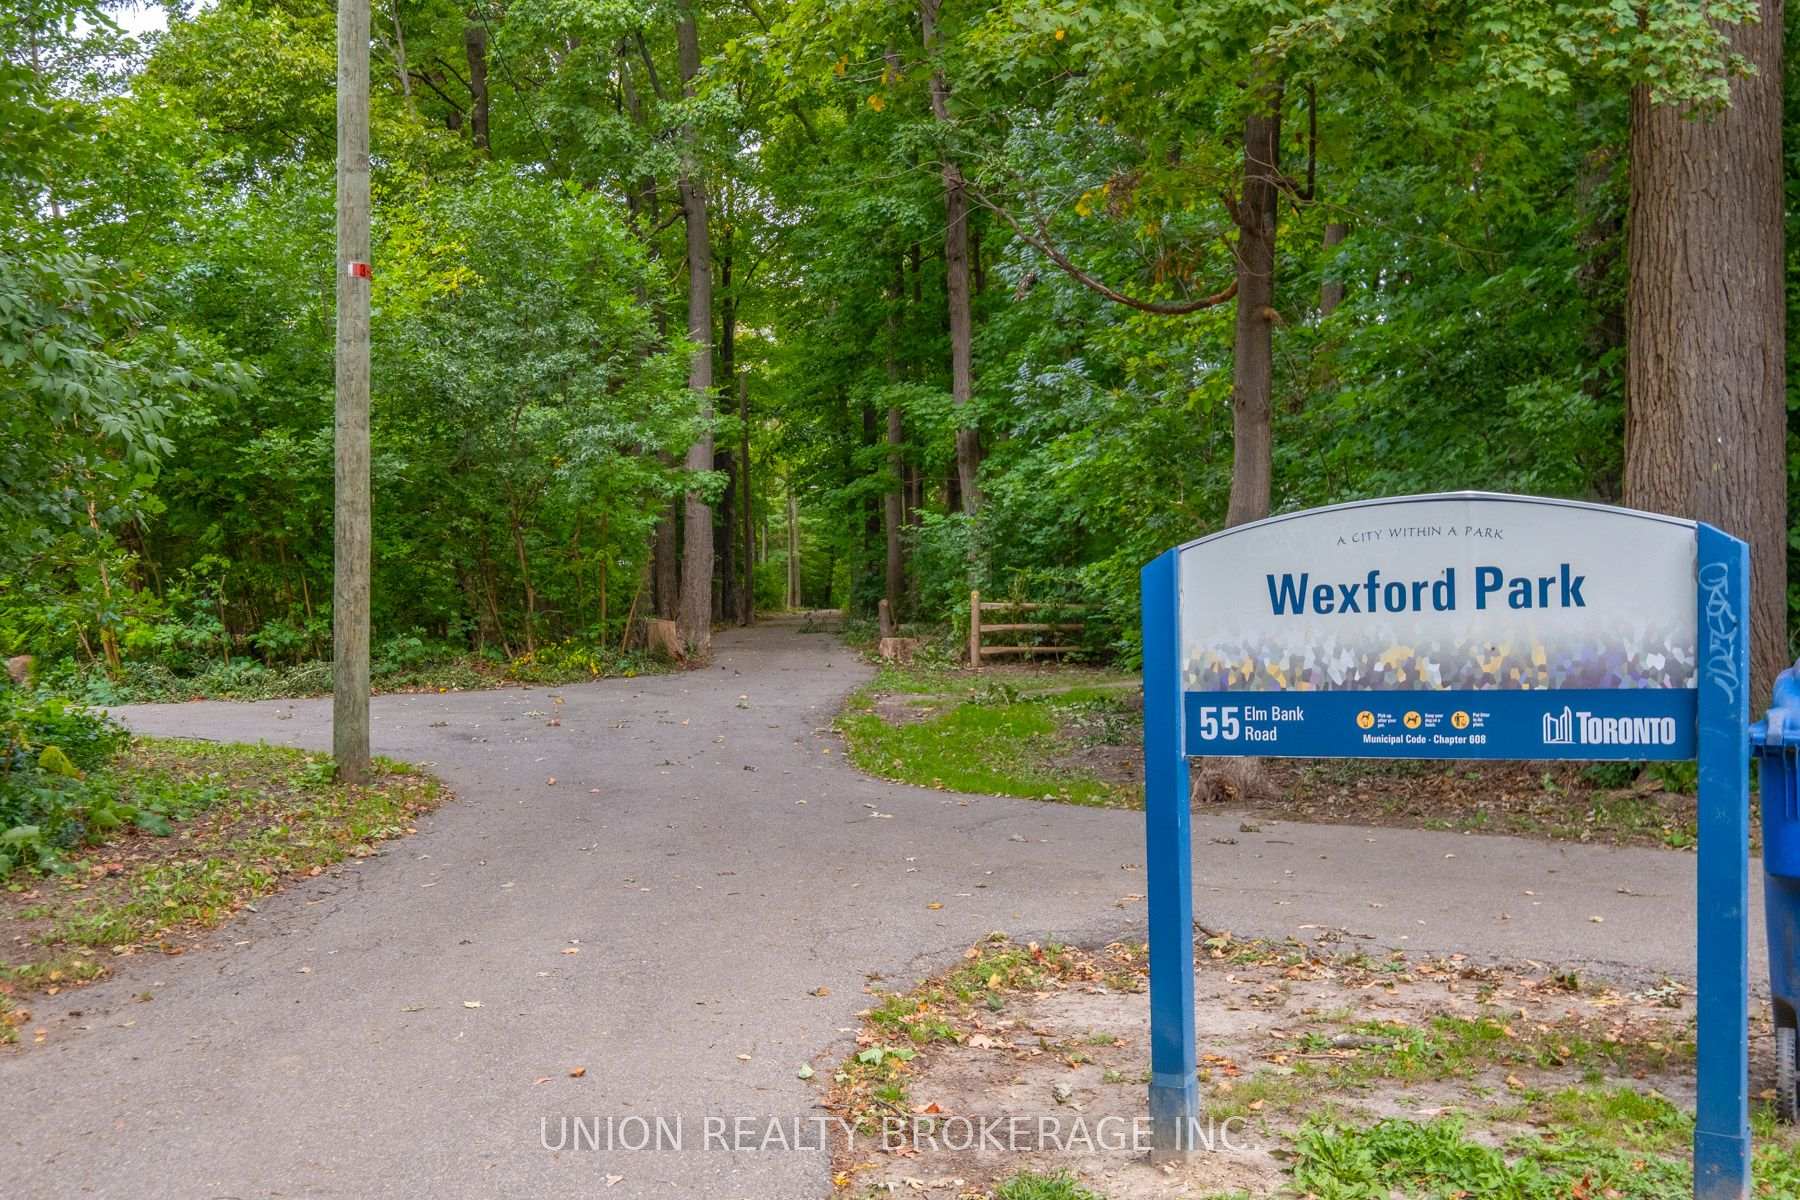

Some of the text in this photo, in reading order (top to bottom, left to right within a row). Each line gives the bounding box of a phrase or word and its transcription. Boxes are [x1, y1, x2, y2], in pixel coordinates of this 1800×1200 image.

[1337, 526, 1503, 546] A CITY WITHIN A PARK
[1266, 563, 1586, 615] Wexford Park
[1200, 706, 1240, 740] 55
[1244, 706, 1304, 721] Elm Bank
[1244, 726, 1277, 741] Road
[1576, 711, 1676, 745] TORONTO
[1363, 734, 1403, 745] Municipal
[1405, 734, 1426, 744] Code
[1433, 734, 1466, 746] Chapter
